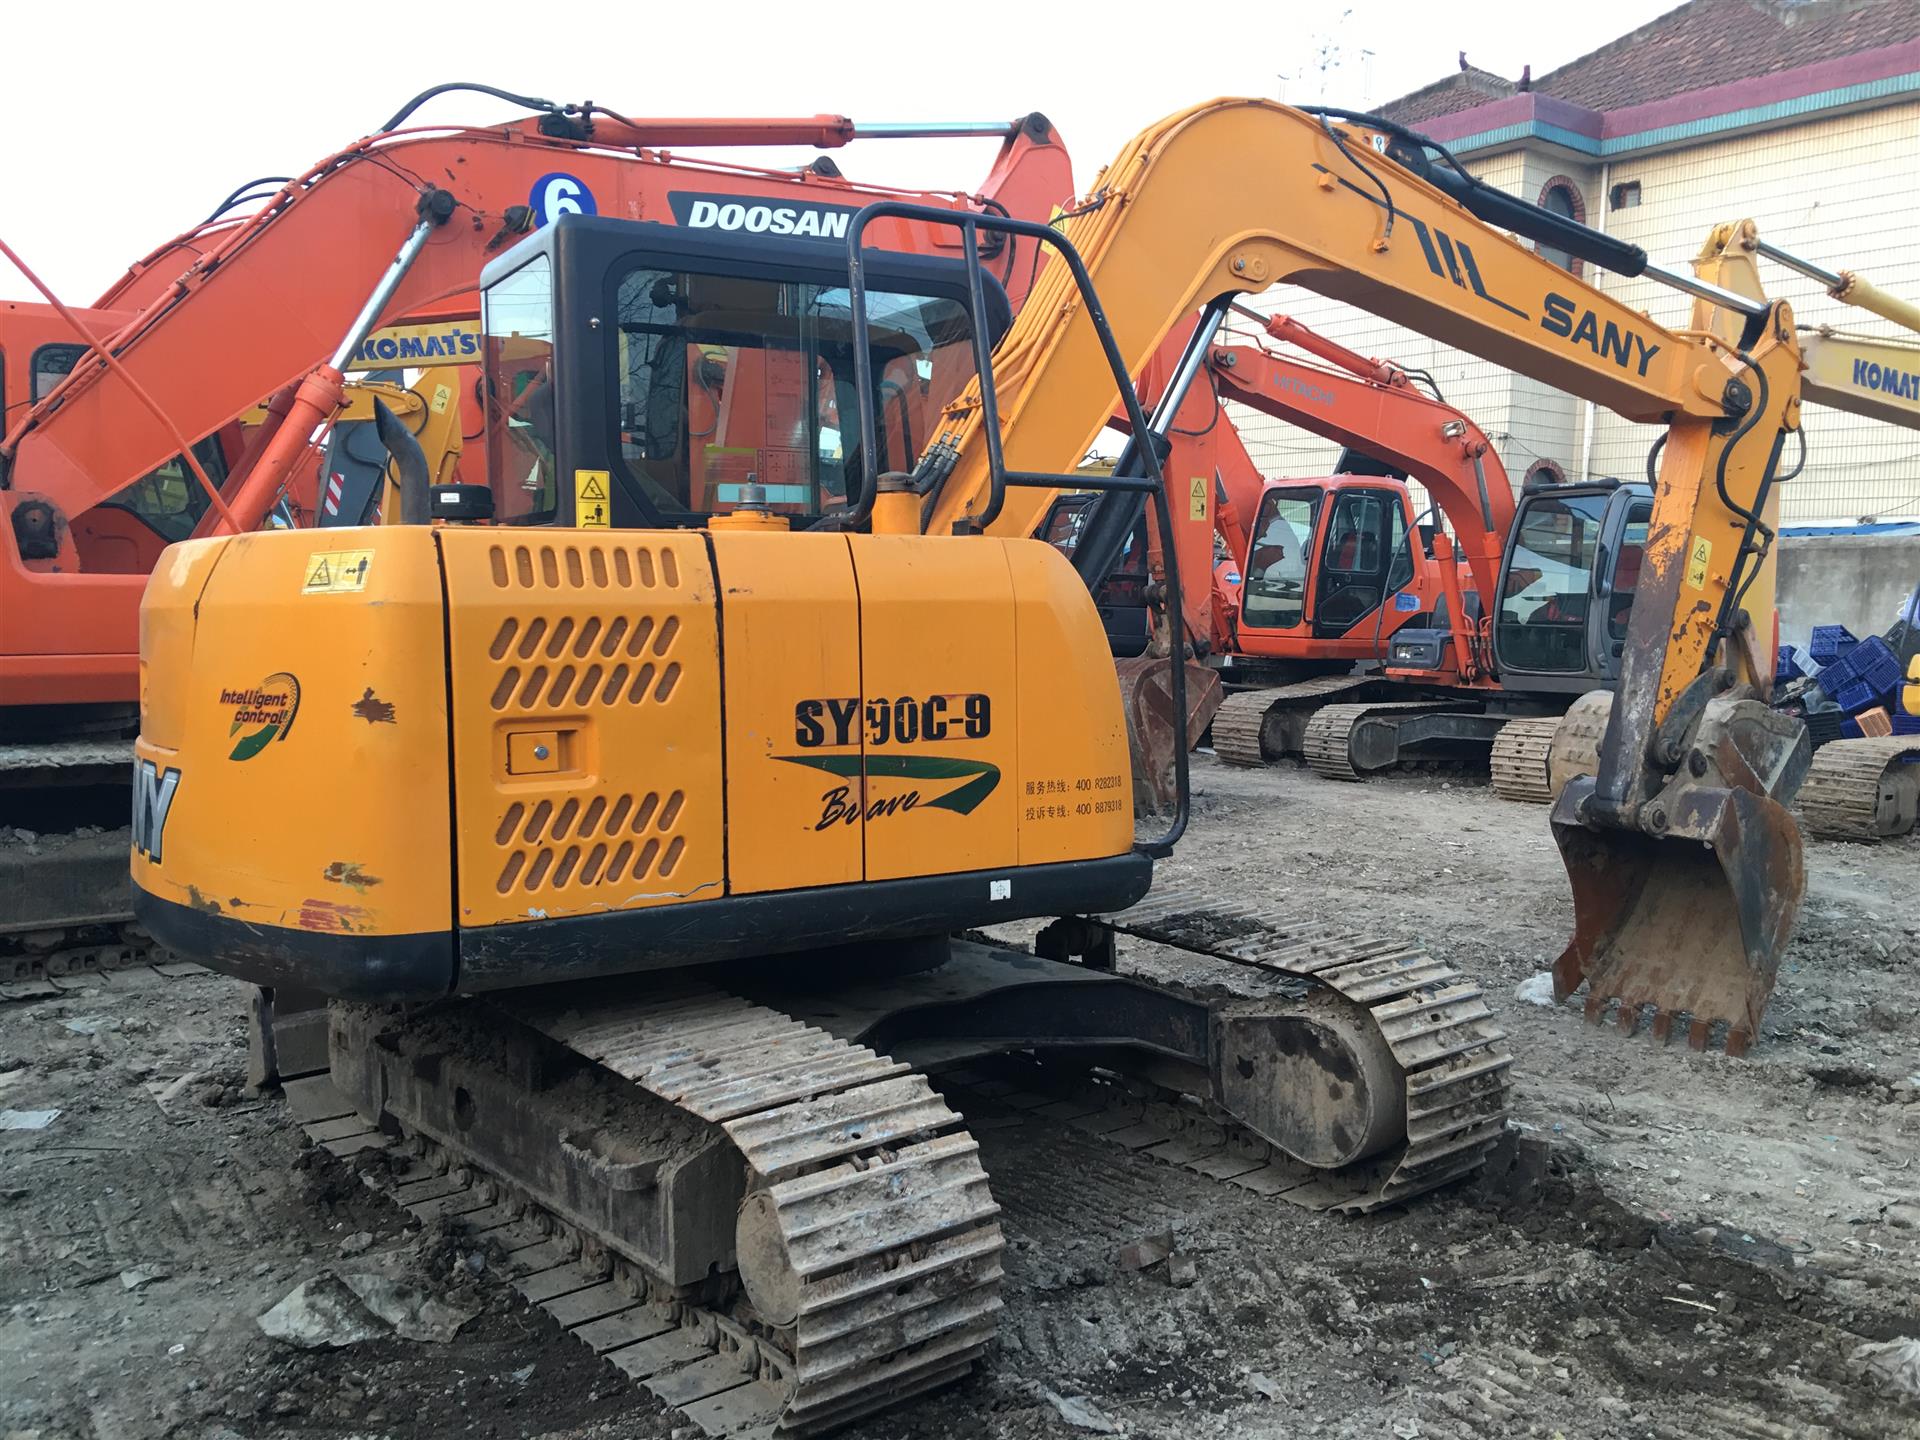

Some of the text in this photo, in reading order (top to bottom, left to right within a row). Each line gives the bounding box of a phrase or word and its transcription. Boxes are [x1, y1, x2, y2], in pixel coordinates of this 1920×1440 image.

[544, 178, 583, 219] 6
[688, 200, 850, 239] DOOSAN
[1540, 291, 1661, 378] SANY
[220, 688, 288, 710] Intelligent
[795, 693, 991, 747] SY90C-9
[1075, 778, 1092, 791] 400
[815, 786, 920, 831] Brave
[1075, 802, 1092, 815] 400
